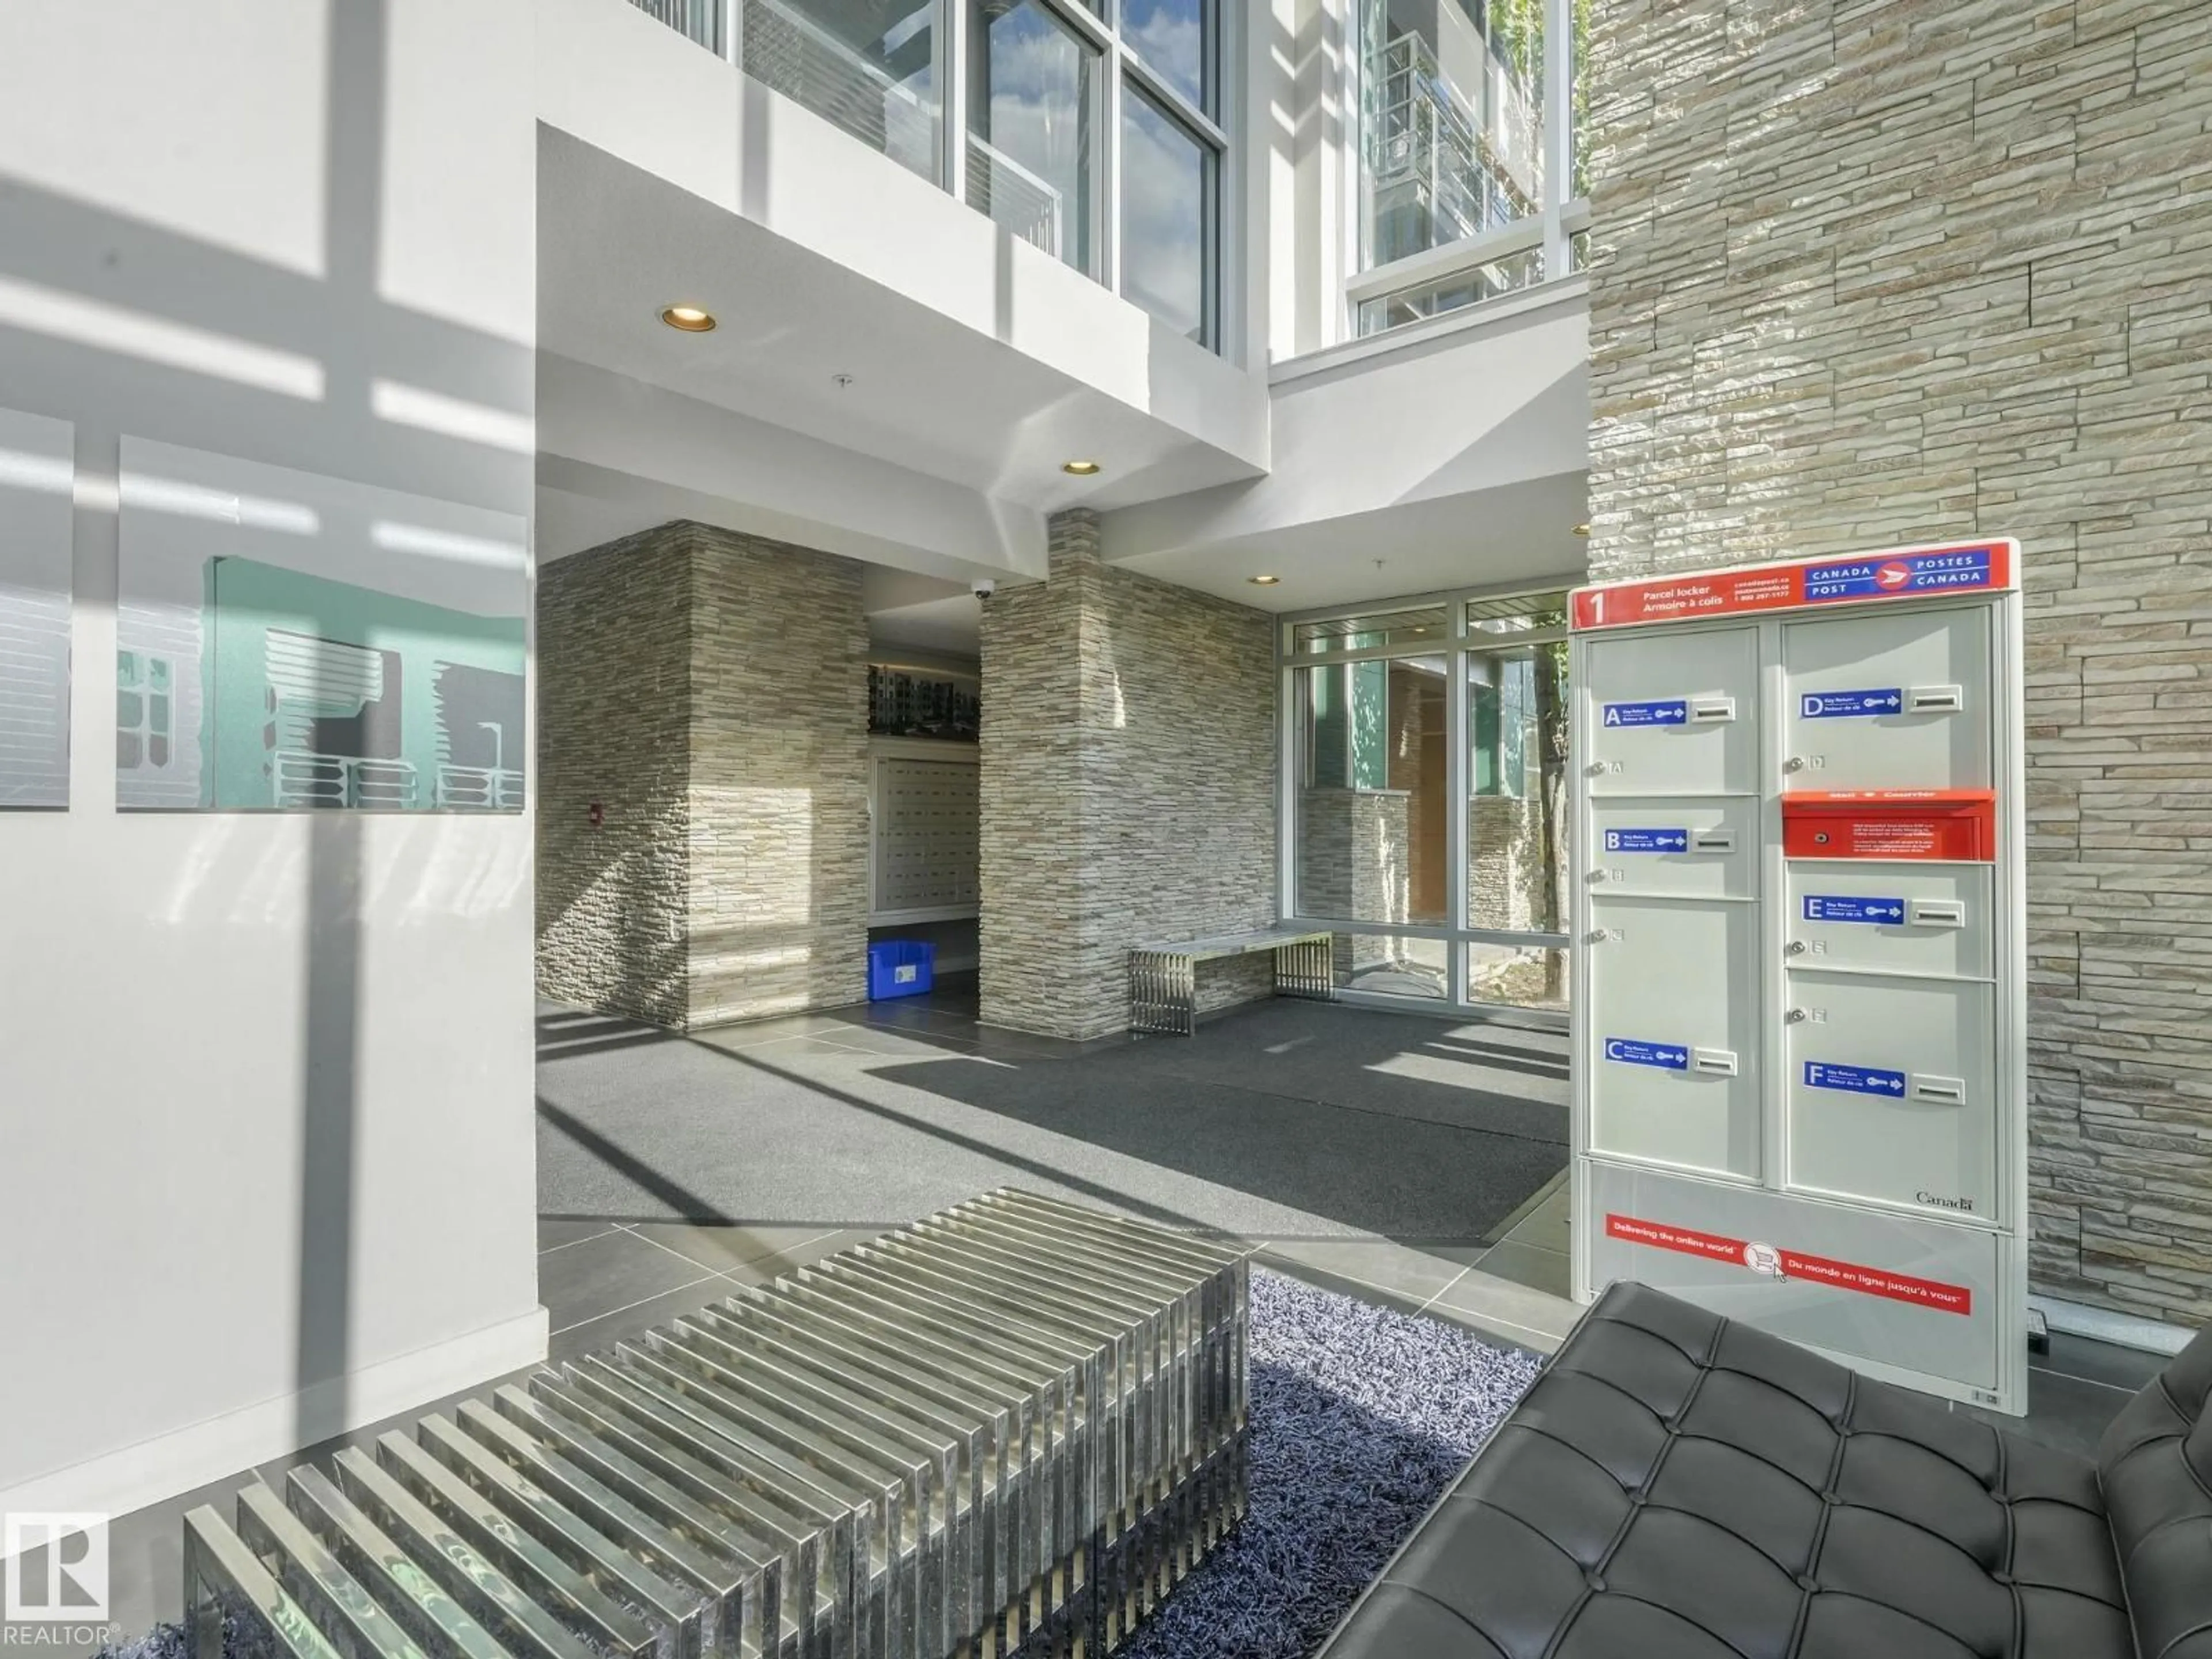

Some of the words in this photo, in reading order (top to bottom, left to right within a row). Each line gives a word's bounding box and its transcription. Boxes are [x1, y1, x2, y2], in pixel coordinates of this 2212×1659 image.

[1916, 556, 1974, 569] POSTES
[1812, 567, 1870, 580] CANADA
[1917, 572, 1981, 585] CANADA
[1643, 588, 1674, 601] Parcel
[1677, 586, 1710, 597] locker
[1812, 584, 1847, 596] POST
[1589, 592, 1604, 624] 1
[1643, 600, 1687, 612] Armoire
[1689, 598, 1696, 607] à
[1699, 596, 1724, 607] colis
[1804, 696, 1823, 715] D
[1605, 707, 1622, 725] A
[1607, 832, 1620, 849] B
[1809, 899, 1823, 918] E
[1608, 1041, 1623, 1059] C
[1810, 1065, 1823, 1084] F
[1916, 1191, 1972, 1210] Canada
[1614, 1222, 1657, 1240] Delivering
[1659, 1232, 1674, 1242] the
[1676, 1237, 1705, 1248] online
[1788, 1259, 1803, 1269] Du
[1805, 1262, 1841, 1278] monde
[1843, 1272, 1857, 1282] en
[1858, 1274, 1885, 1287] ligne
